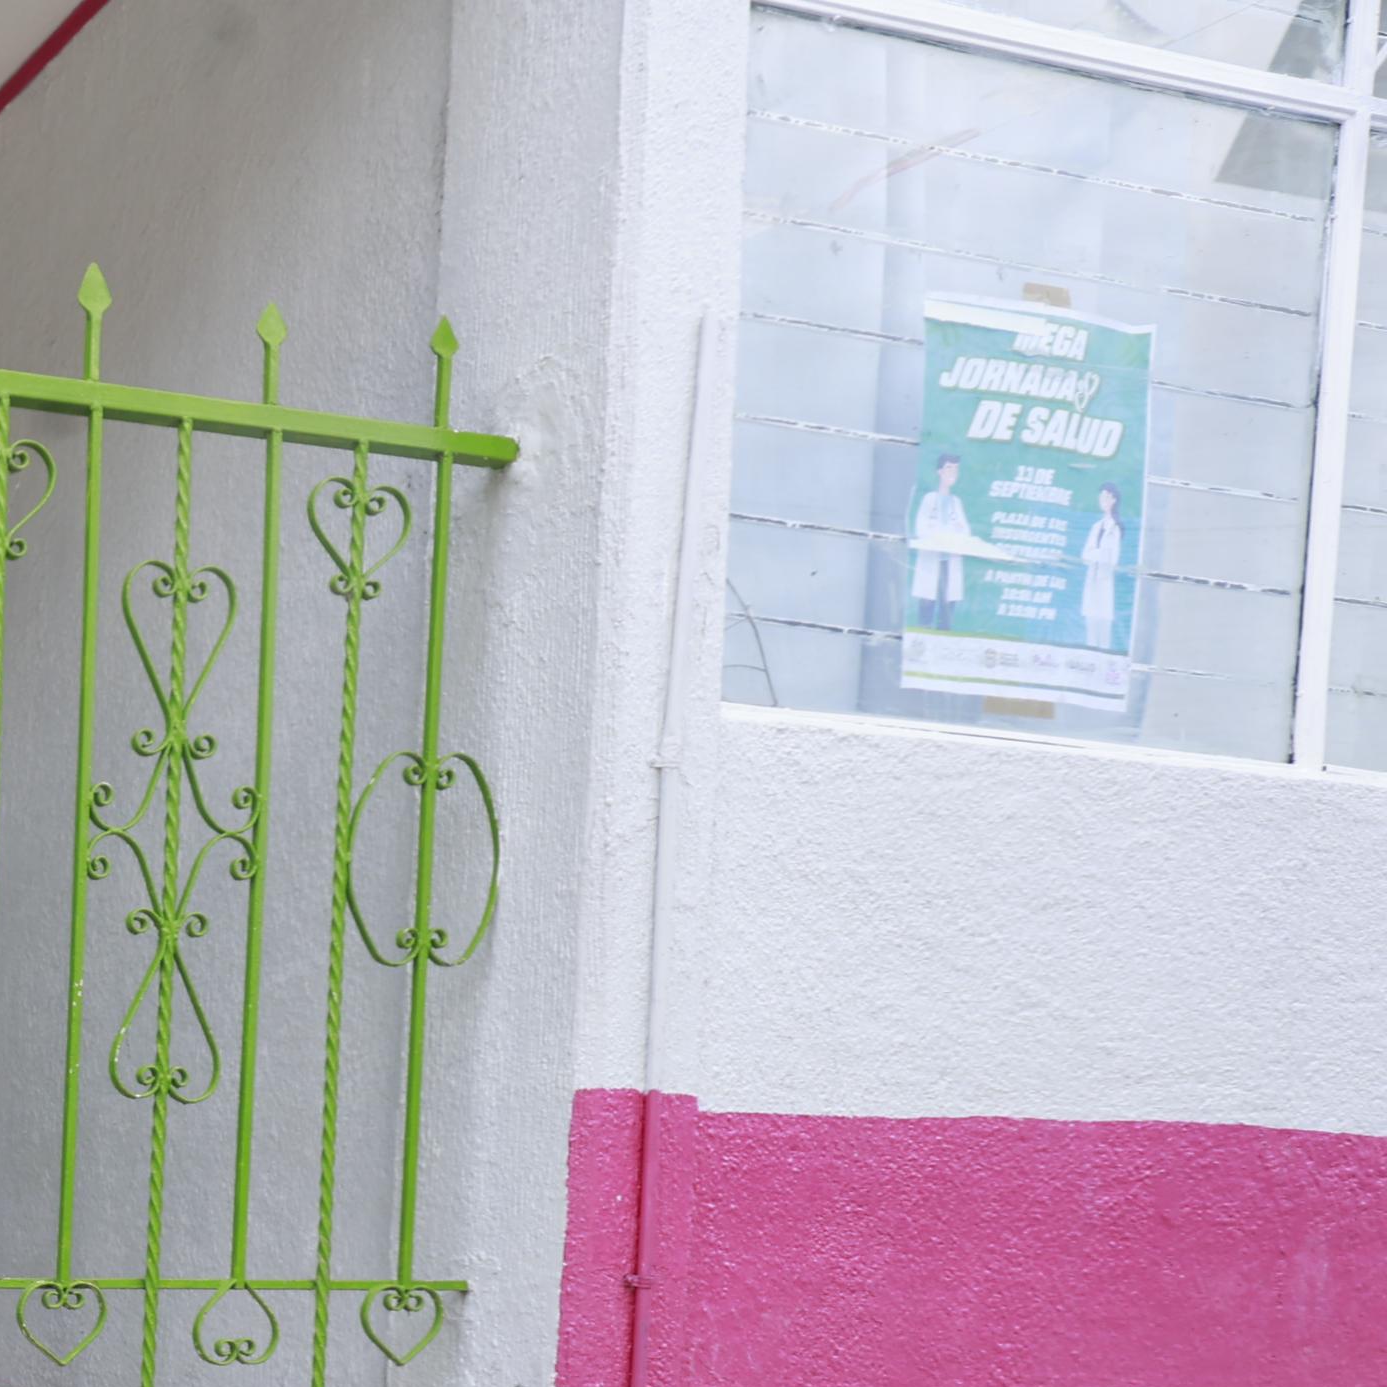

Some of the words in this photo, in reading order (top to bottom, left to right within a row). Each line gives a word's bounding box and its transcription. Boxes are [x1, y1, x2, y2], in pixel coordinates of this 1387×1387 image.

[939, 356, 1077, 402] JORNADA
[967, 400, 1023, 441] DE
[1020, 406, 1124, 458] SALUD
